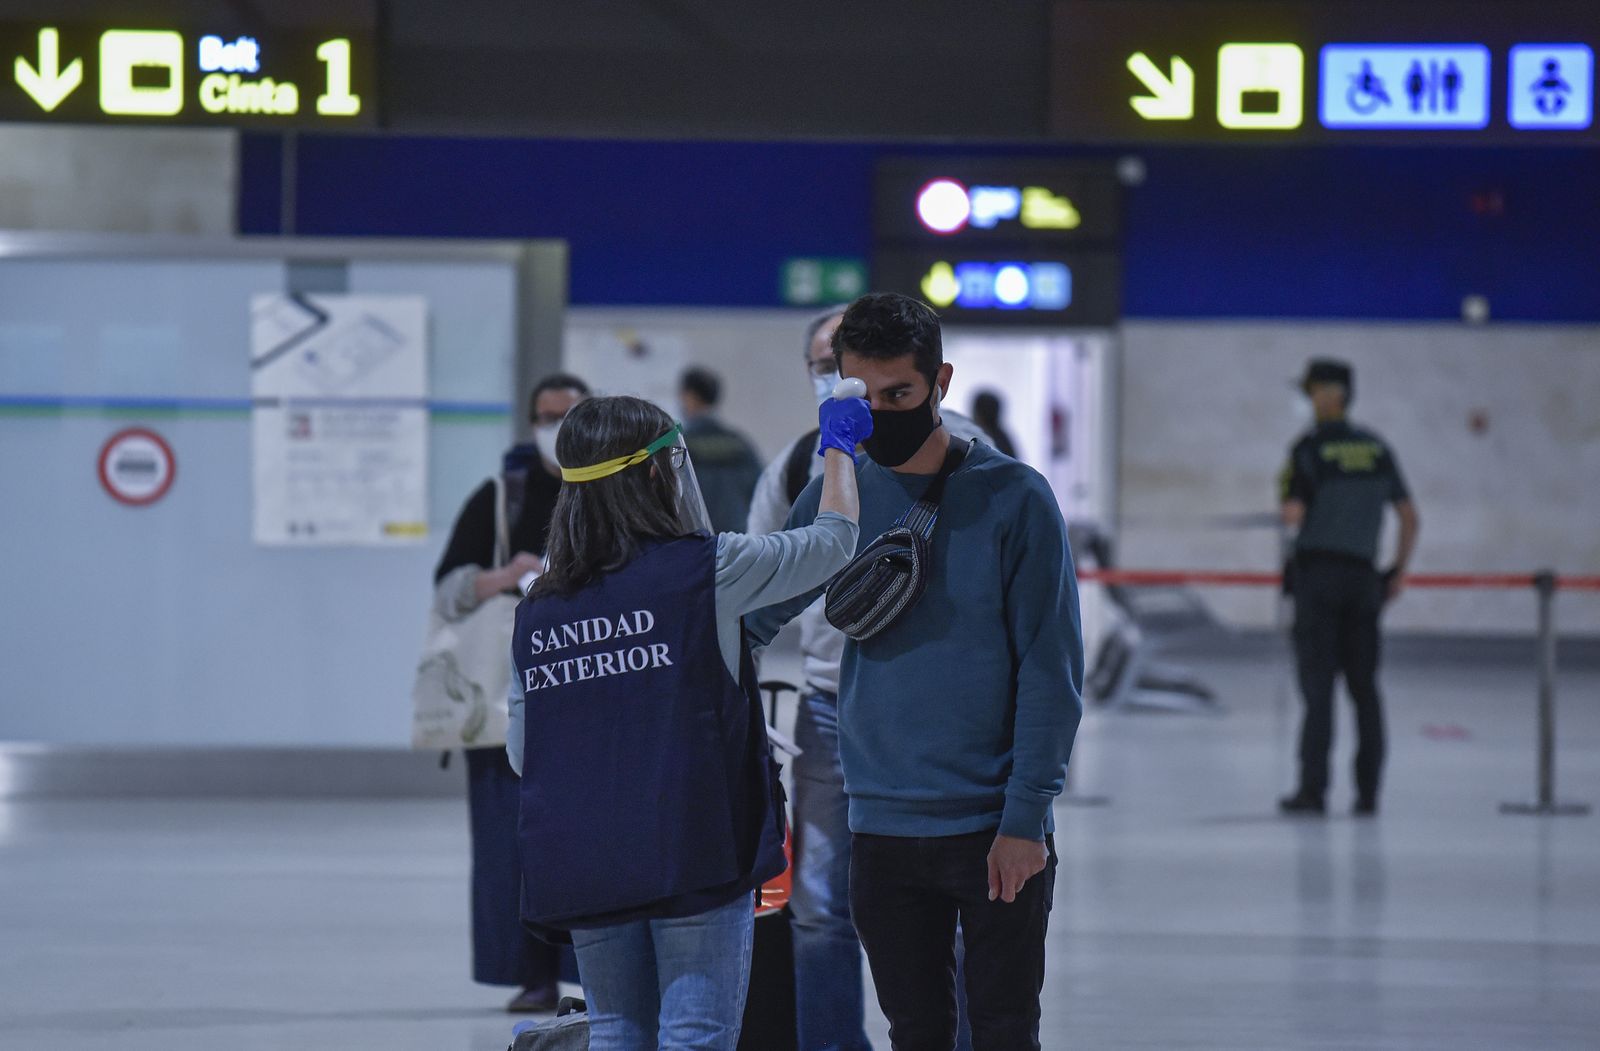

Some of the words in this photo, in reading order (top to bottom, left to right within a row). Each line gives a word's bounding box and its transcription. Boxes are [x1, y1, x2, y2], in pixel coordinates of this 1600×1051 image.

[199, 35, 259, 72] Belt
[316, 38, 361, 115] 1
[199, 73, 298, 114] Cinta
[530, 609, 655, 656] SANIDAD
[523, 642, 674, 693] EXTERIOR
